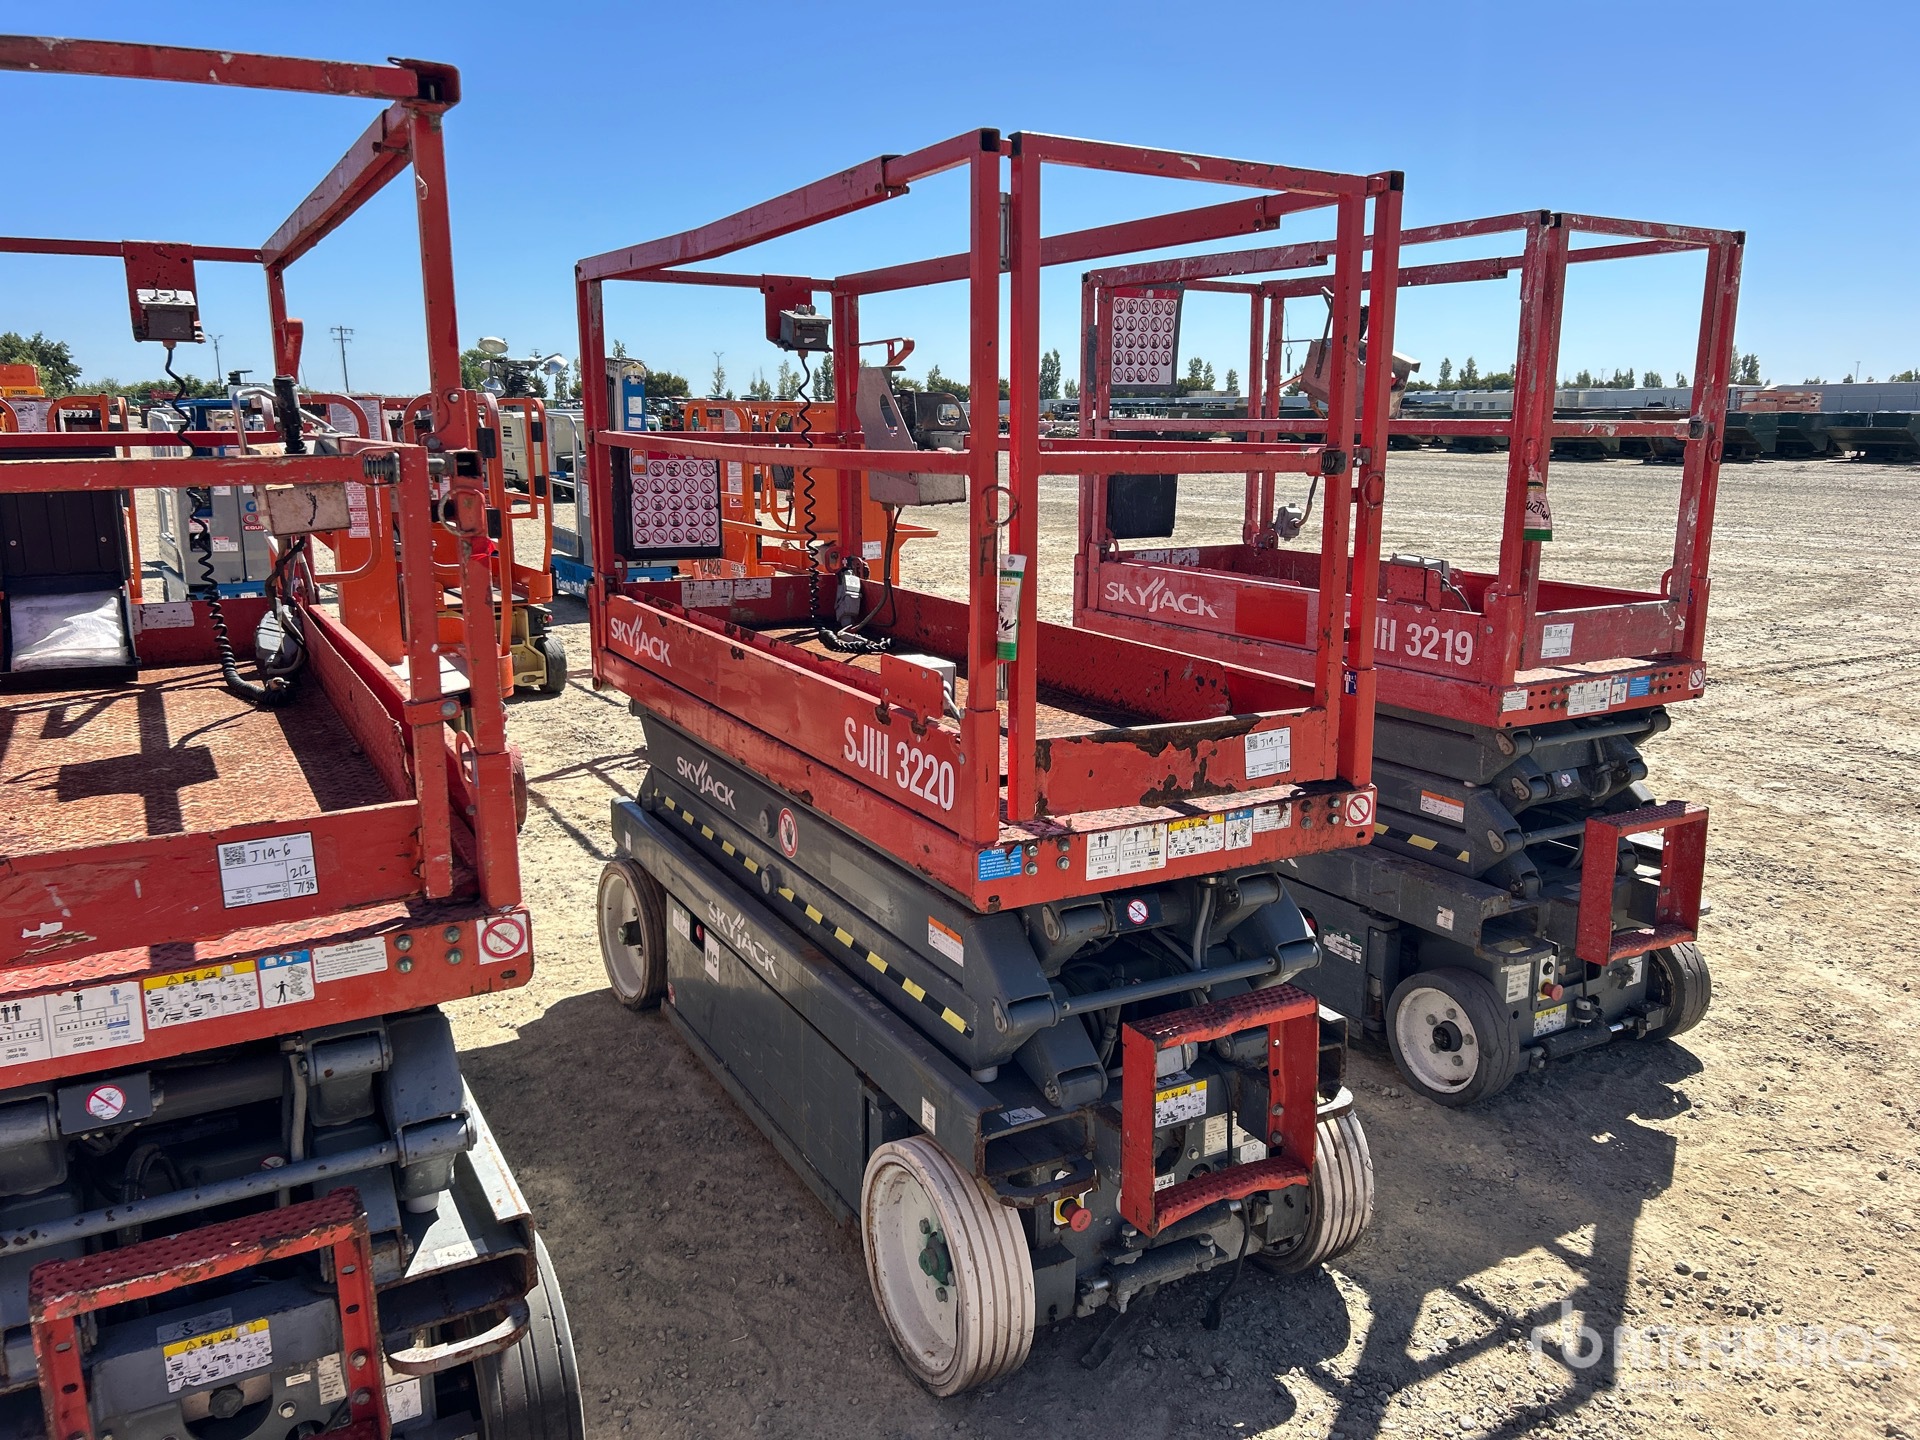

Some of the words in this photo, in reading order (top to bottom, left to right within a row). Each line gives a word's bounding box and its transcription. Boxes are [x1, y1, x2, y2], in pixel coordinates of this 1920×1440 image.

[1104, 577, 1219, 619] SKYJACK
[610, 614, 672, 667] SKYJACK
[1405, 622, 1474, 666] 3219
[676, 756, 736, 810] SKYJACK
[843, 716, 889, 779] SJIII
[895, 741, 955, 811] 3220
[706, 948, 718, 969] MC
[707, 900, 778, 980] SKYJACK
